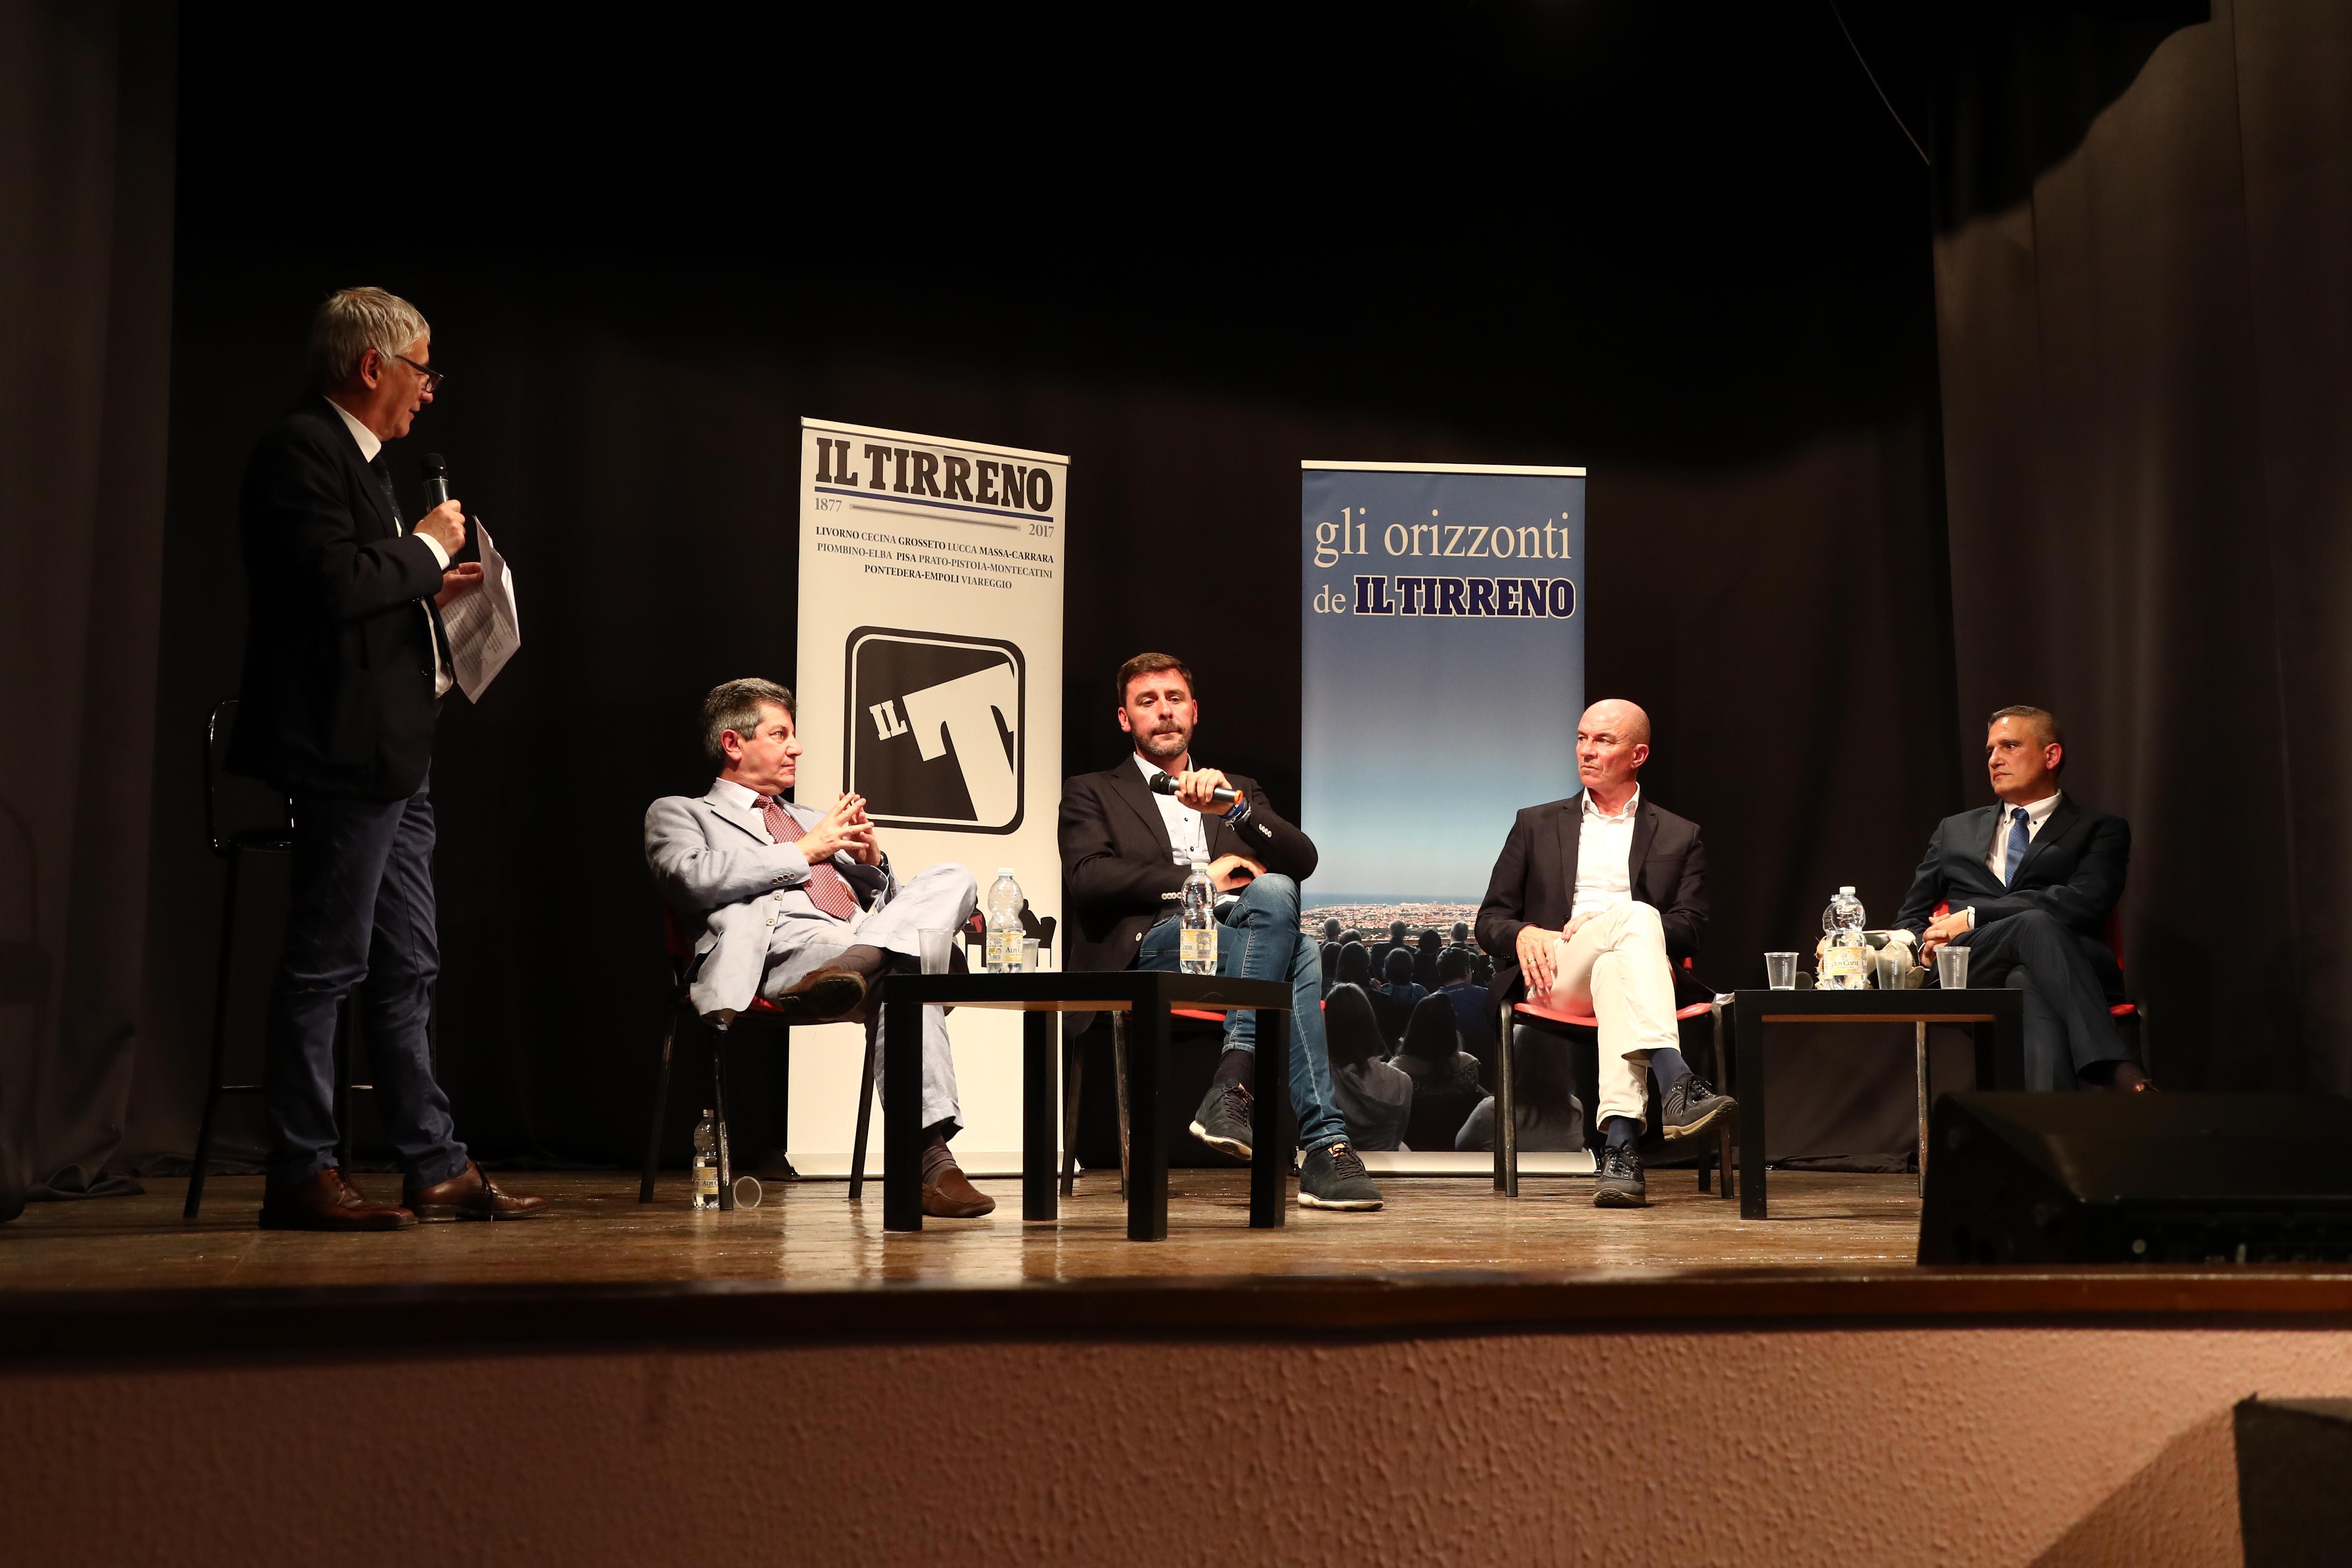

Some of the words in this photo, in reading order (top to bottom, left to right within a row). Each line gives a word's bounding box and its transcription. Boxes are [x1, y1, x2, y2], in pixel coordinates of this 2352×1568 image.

[816, 437, 858, 487] IL
[864, 444, 1053, 512] TIRRENO
[815, 497, 842, 512] 1877
[816, 526, 859, 540] LIVORNO
[861, 532, 896, 545] CECINA
[898, 536, 946, 550] GROSSETO
[948, 543, 977, 554] LUCCA
[980, 546, 1054, 564] MASSA-CARRARA
[1029, 524, 1054, 538] 2017
[1314, 507, 1369, 568] gli
[1384, 509, 1571, 559] orizzonti
[818, 542, 892, 560] PIOMBINO-ELBA
[896, 552, 917, 563] PISA
[919, 554, 1053, 579] PRATO-PISTOIA-MONTECATINI
[864, 564, 959, 584] PONTEDERA-EMPOLI
[962, 576, 1012, 589] VIAREGGIO
[1313, 584, 1346, 614] de
[1354, 575, 1395, 616] IL
[1395, 575, 1576, 619] TIRRENO
[869, 700, 908, 741] IL
